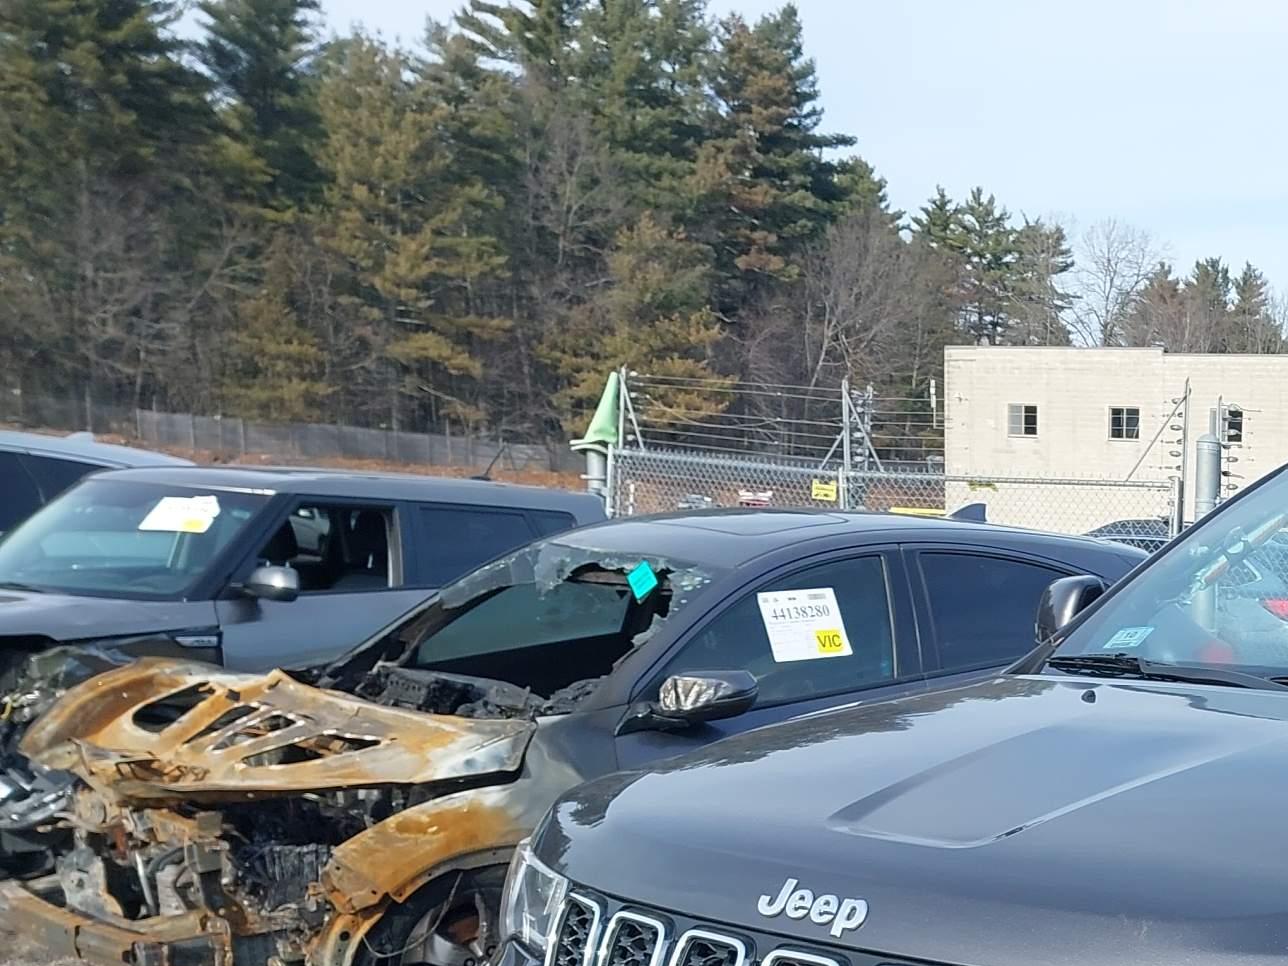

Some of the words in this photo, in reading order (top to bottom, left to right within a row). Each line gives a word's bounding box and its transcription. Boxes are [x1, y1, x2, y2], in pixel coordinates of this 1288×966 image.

[771, 604, 830, 620] 44138280
[816, 634, 842, 648] VIC
[757, 877, 869, 938] Jeep
